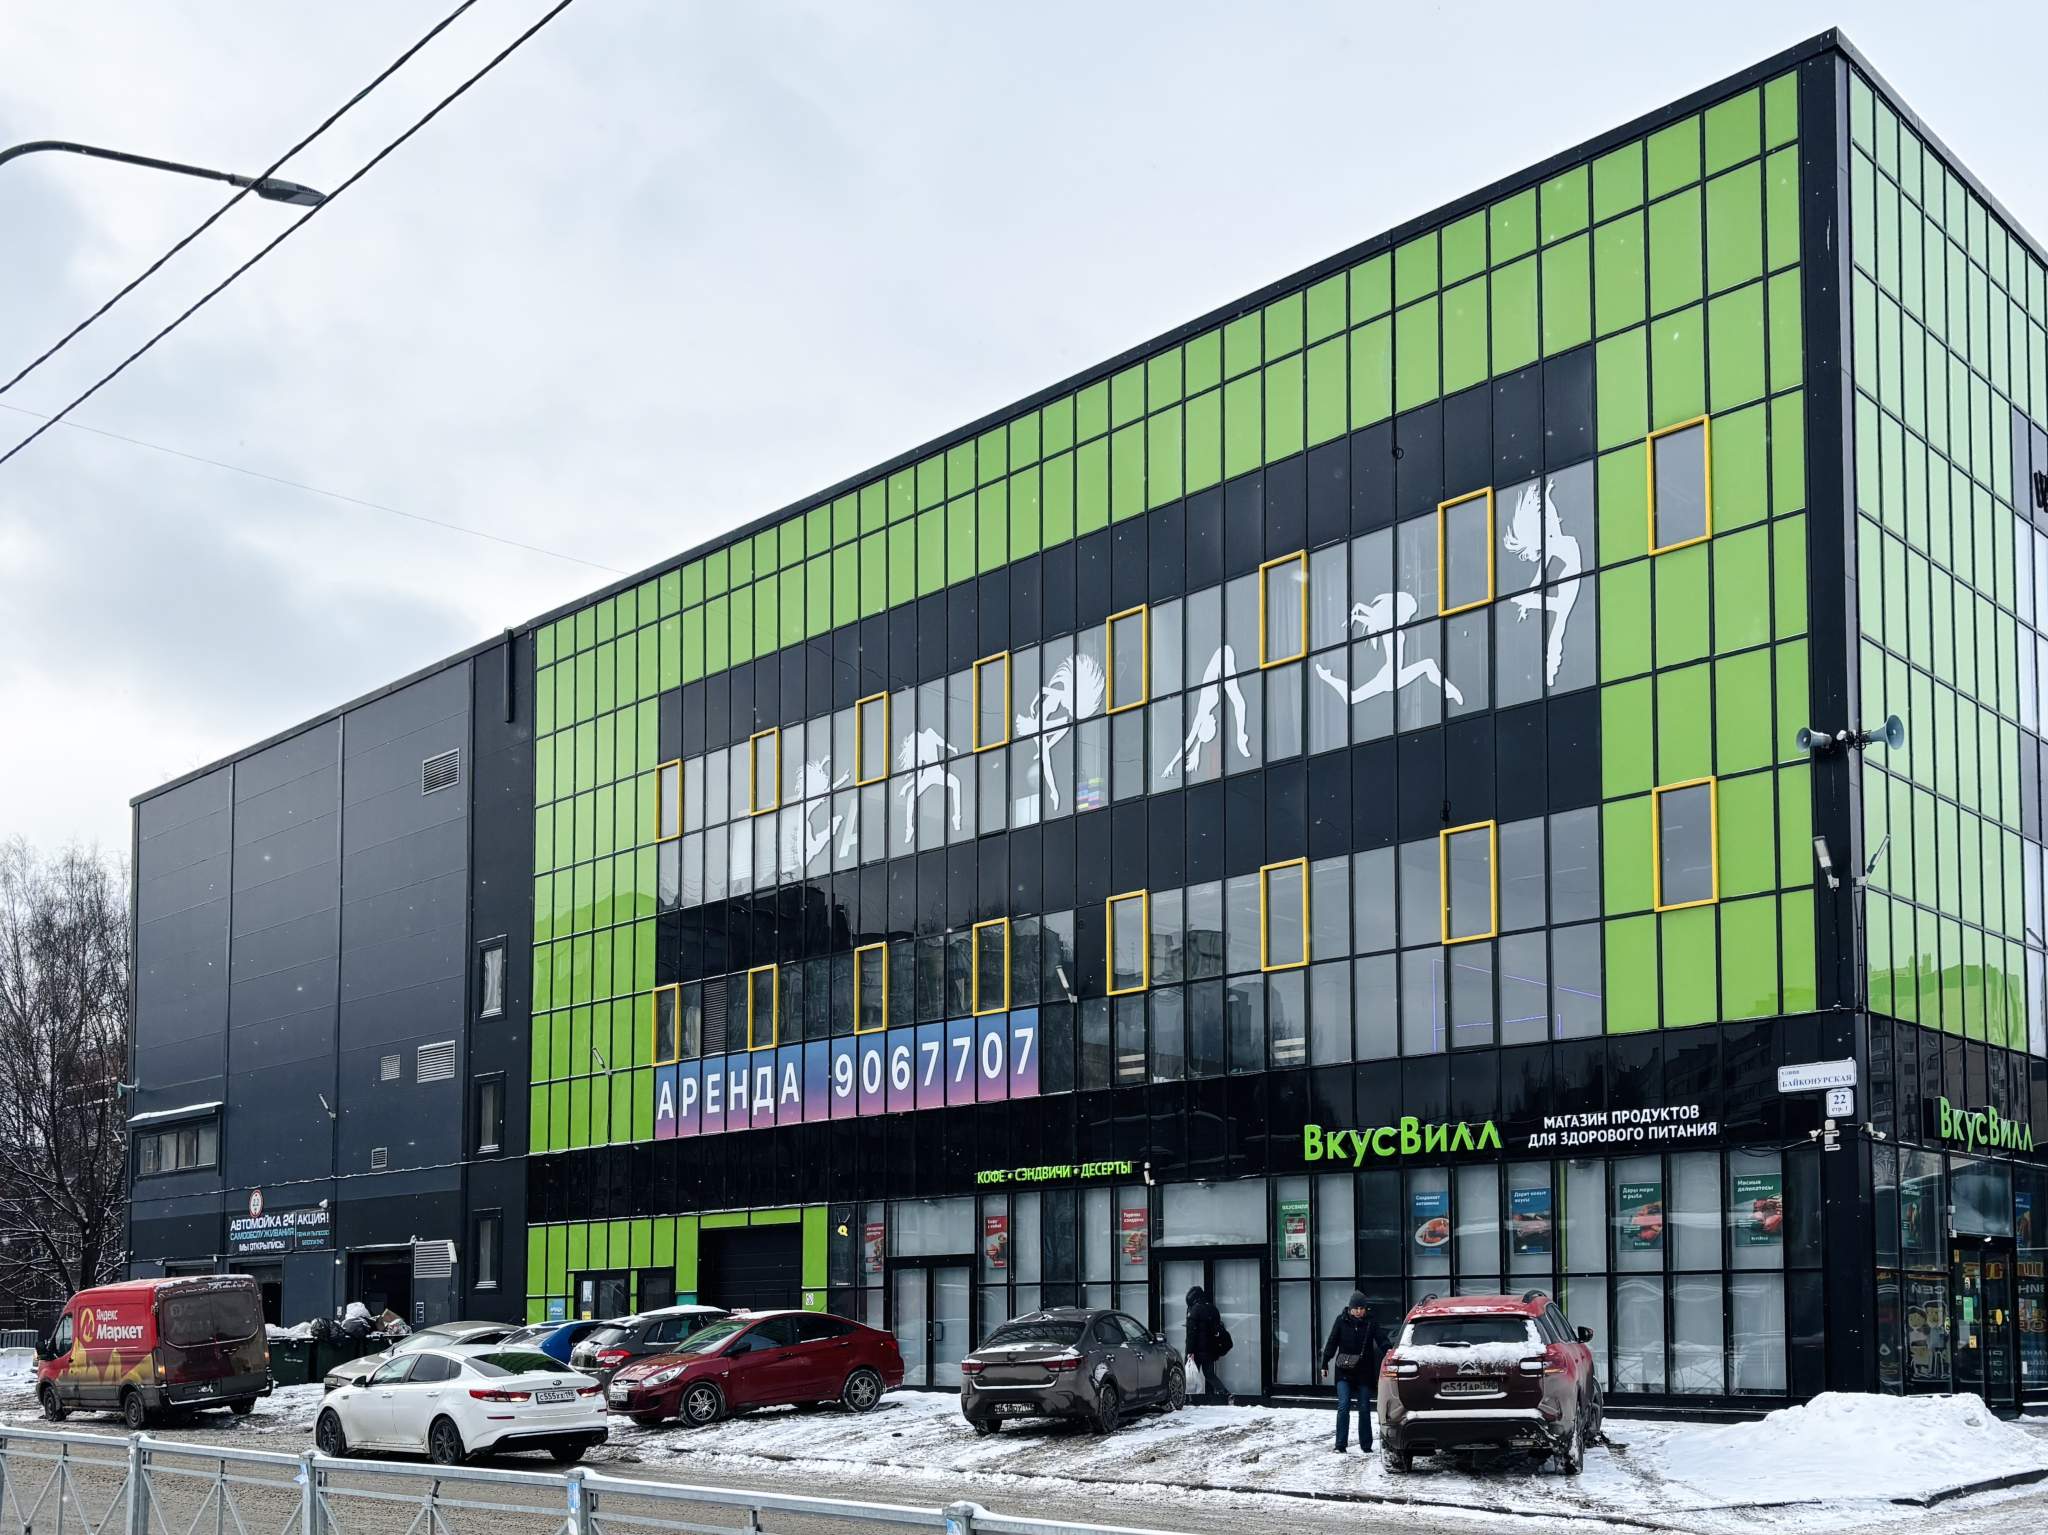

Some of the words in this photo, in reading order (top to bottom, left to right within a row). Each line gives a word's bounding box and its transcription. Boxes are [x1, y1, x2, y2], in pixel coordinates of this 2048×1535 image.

[657, 1062, 800, 1120] АРЕНДА
[834, 1028, 1034, 1098] 9067707
[1782, 1074, 1852, 1088] БАЙКОНУРСКАЯ
[1833, 1094, 1846, 1105] 22
[1544, 1112, 1608, 1129] МАГАЗИН
[1612, 1105, 1700, 1125] ПРОДУКТОВ
[1939, 1096, 2034, 1152] ВкусВилл
[1304, 1116, 1503, 1167] ВкусВилл
[1528, 1132, 1556, 1149] ДЛЯ
[1560, 1127, 1644, 1146] ЗДОРОВОГО
[1648, 1121, 1717, 1140] ПИТАНИЯ
[977, 1170, 1005, 1184] КОФЕ
[1015, 1165, 1072, 1182] СЭНДВИЧИ
[1080, 1161, 1132, 1179] ДЕСЕРТЫ
[230, 1215, 282, 1232] АВТОМОЙКА
[283, 1213, 295, 1226] 24
[297, 1212, 329, 1226] АКЦИЯ!
[230, 1227, 295, 1240] САМООБСЛУЖИВАНИЯ
[239, 1243, 249, 1251] МЫ
[96, 1309, 118, 1321] Яндекс
[97, 1325, 143, 1341] Маркет
